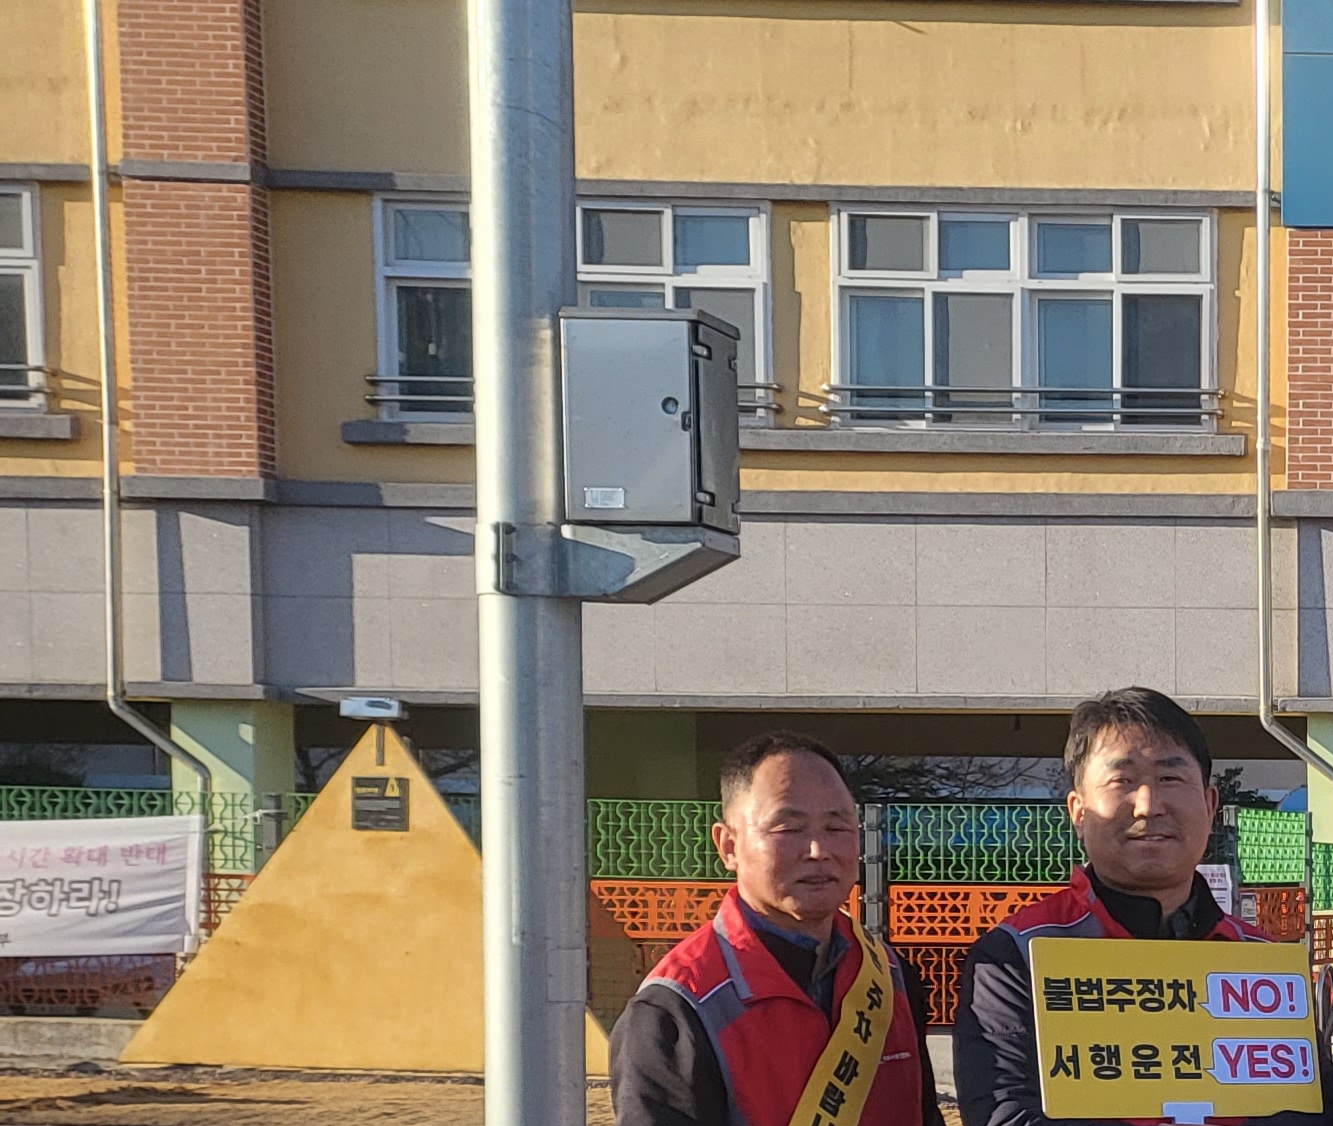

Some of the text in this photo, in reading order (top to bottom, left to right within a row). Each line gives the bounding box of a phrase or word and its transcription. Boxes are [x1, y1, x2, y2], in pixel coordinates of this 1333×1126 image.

[8, 843, 167, 868] 시간 확대 반대
[853, 979, 884, 1045] 주차
[1043, 976, 1297, 1014] 불법주정차 NO!
[1217, 1044, 1311, 1079] YES!
